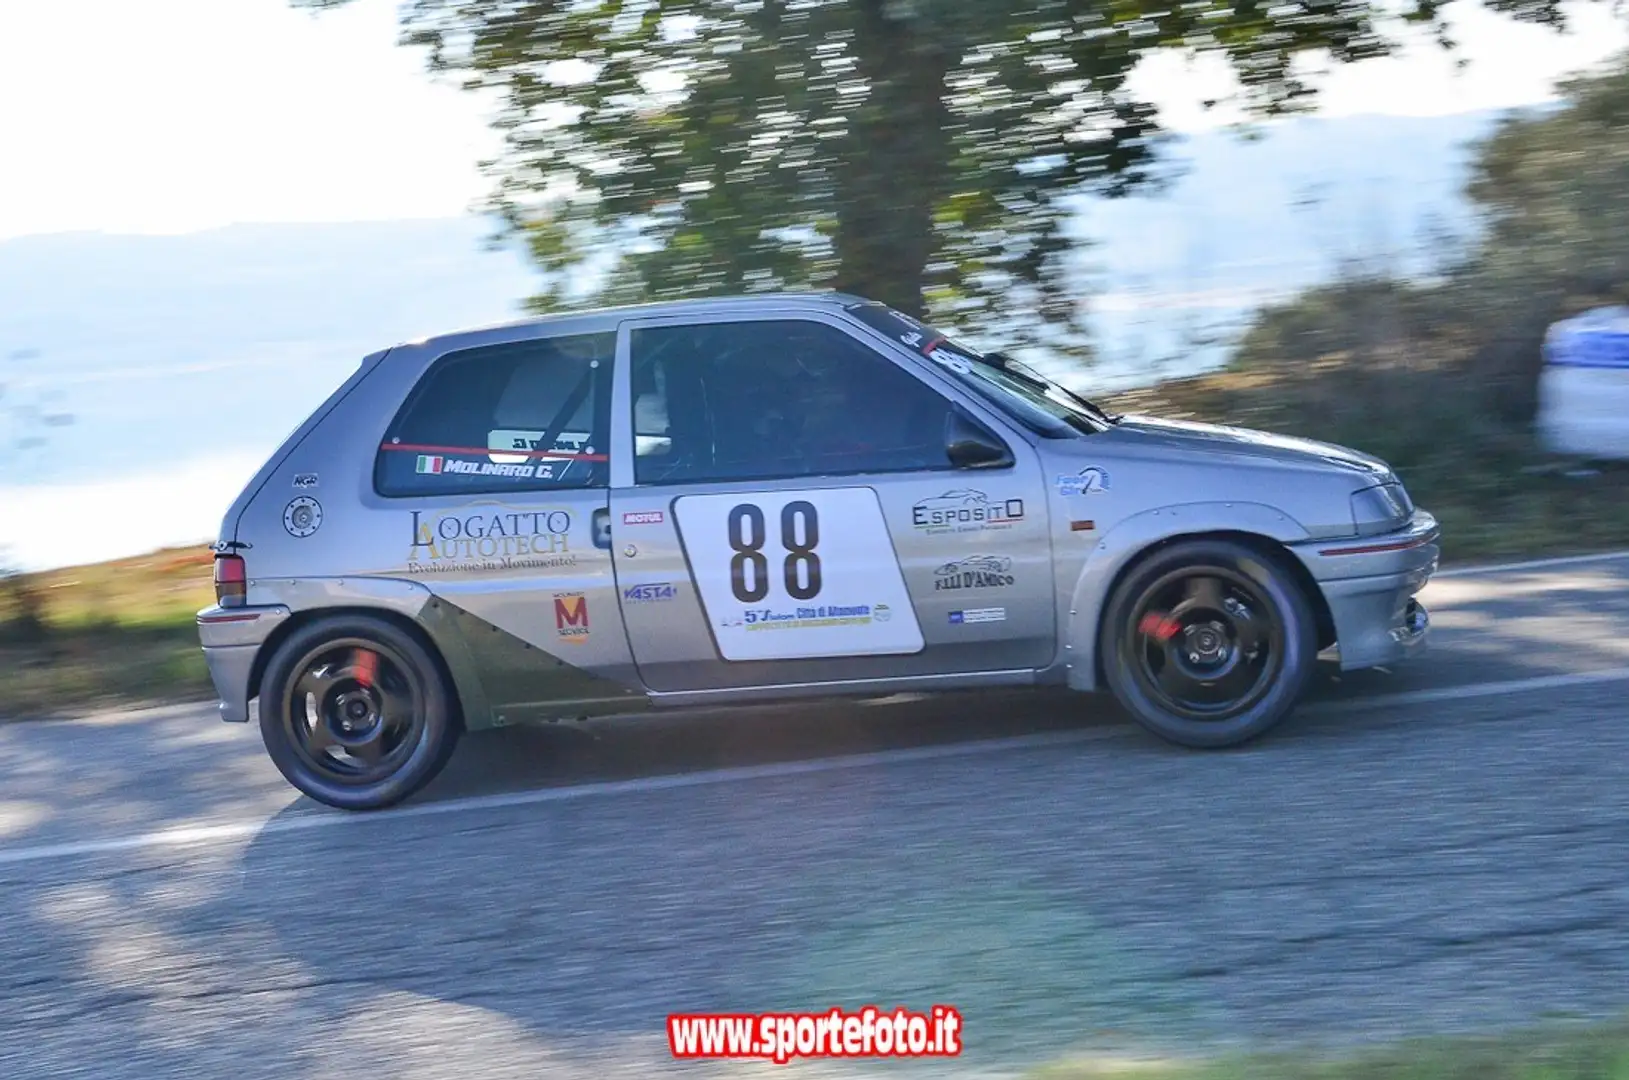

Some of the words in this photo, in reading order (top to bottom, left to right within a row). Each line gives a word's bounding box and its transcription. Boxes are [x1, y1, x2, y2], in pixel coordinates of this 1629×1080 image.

[443, 460, 534, 478] MOLINARO
[535, 465, 553, 479] G.
[625, 512, 662, 523] MOTUL
[912, 499, 1024, 525] ESPOSITO
[407, 522, 569, 561] AUTOTECH
[409, 510, 570, 547] LOGATTO
[728, 500, 822, 603] 88
